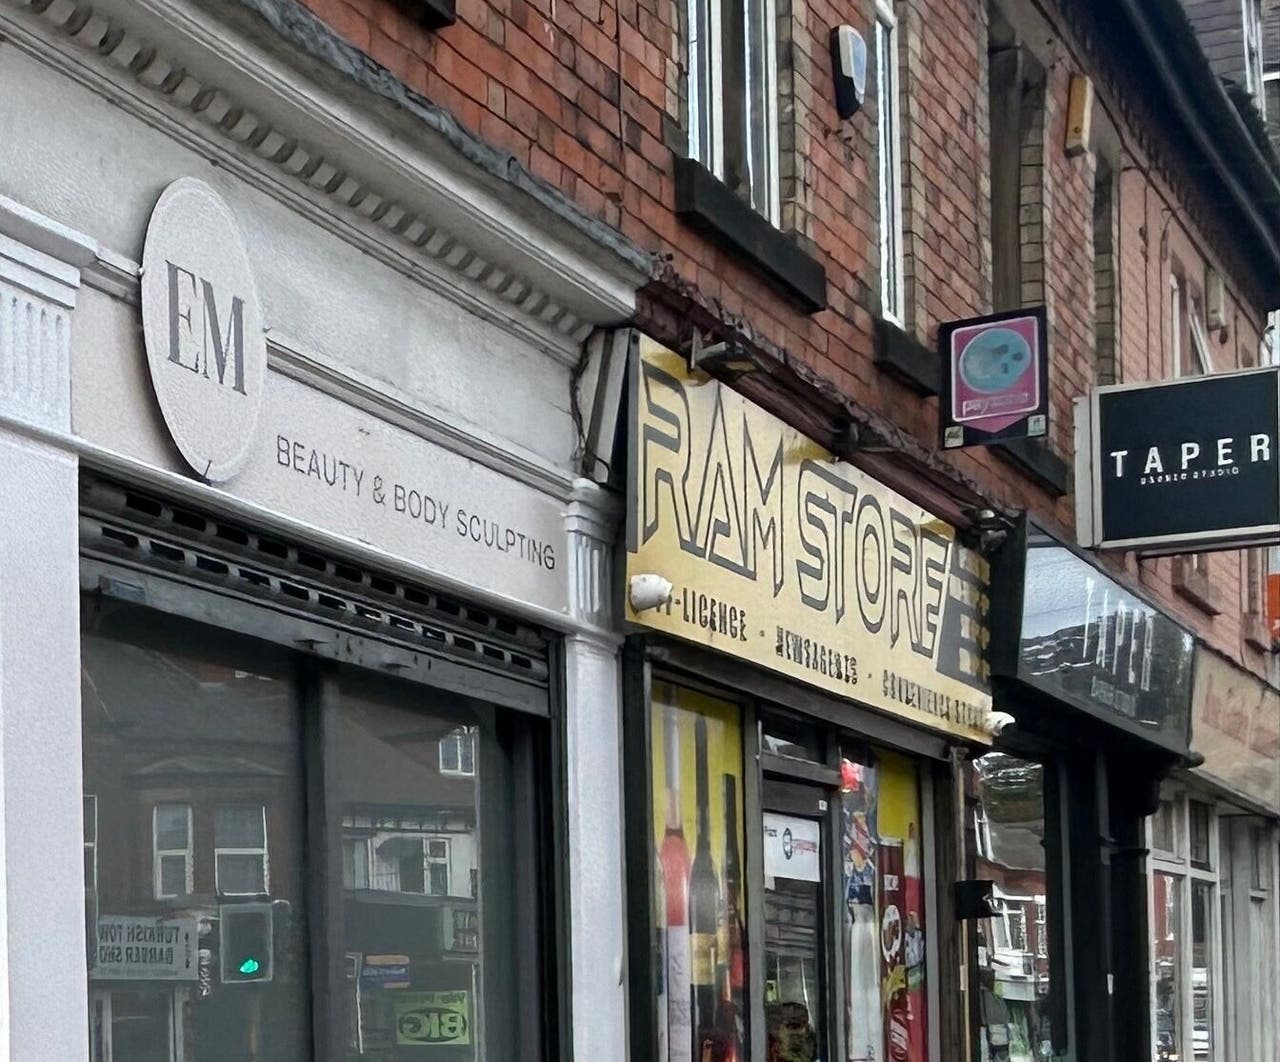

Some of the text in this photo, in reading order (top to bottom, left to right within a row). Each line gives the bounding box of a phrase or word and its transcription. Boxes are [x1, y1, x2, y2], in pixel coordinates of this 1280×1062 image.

[166, 259, 247, 396] EM
[277, 435, 555, 570] BEAUTY & BODY SCULPTING
[641, 358, 951, 659] RAM STORE
[1110, 433, 1270, 478] TAPER
